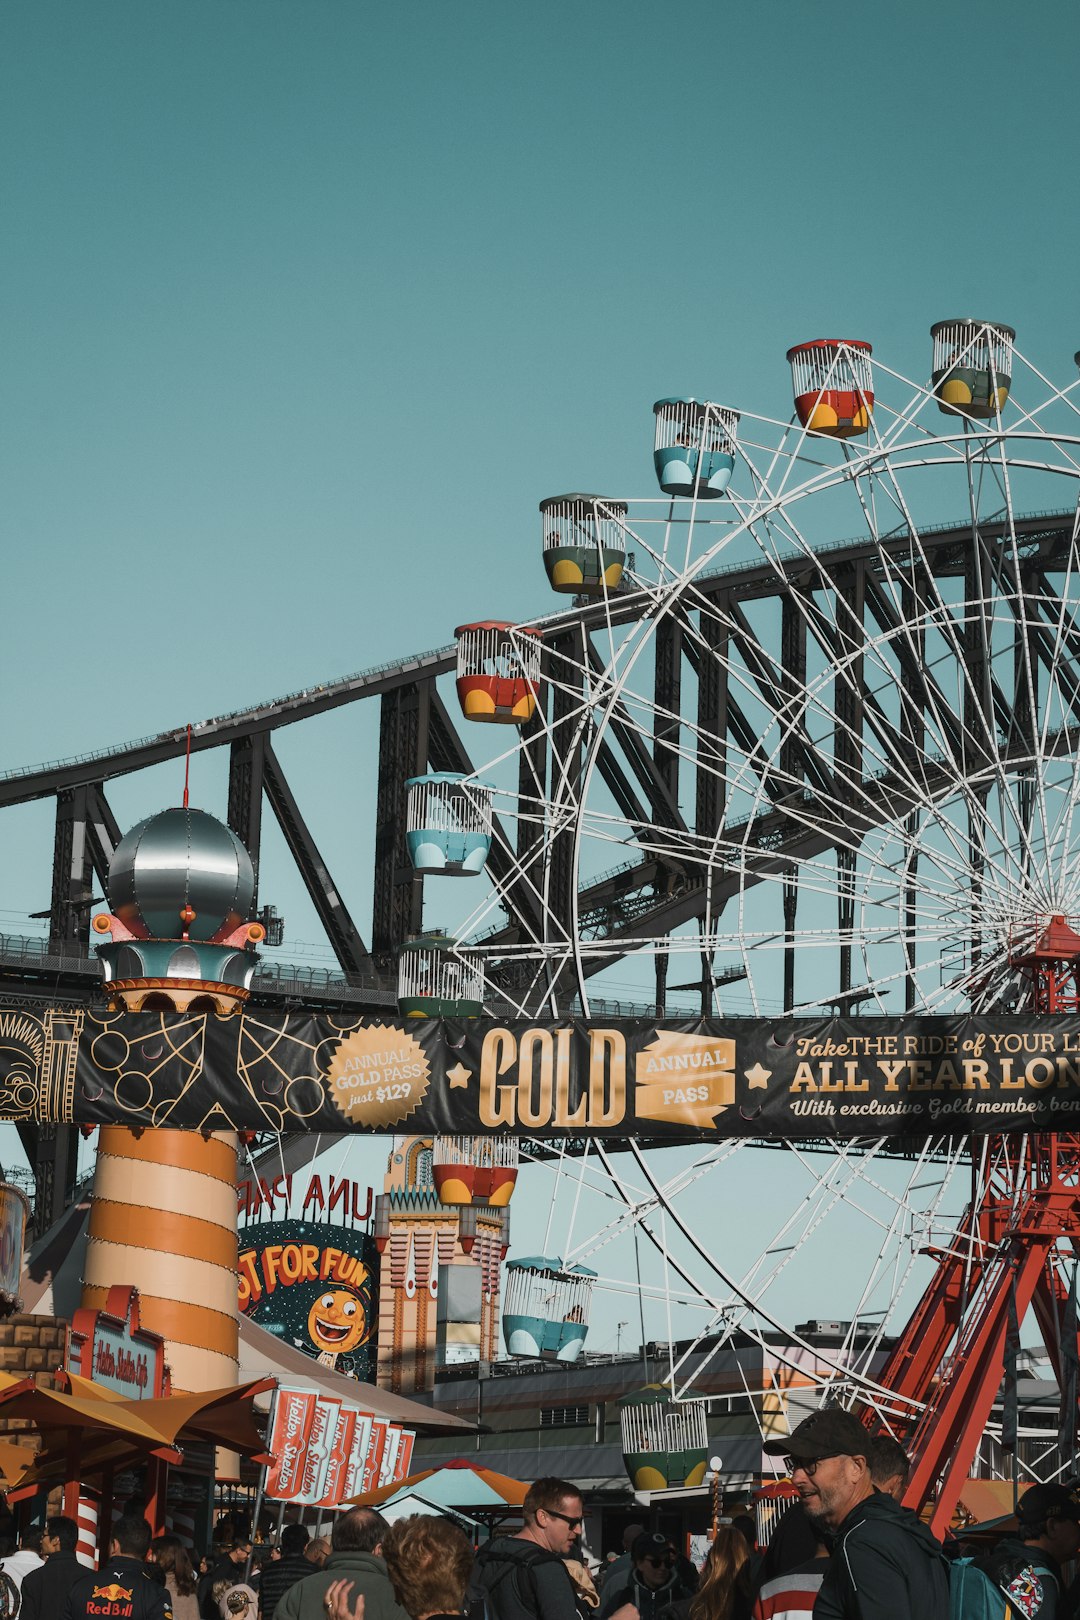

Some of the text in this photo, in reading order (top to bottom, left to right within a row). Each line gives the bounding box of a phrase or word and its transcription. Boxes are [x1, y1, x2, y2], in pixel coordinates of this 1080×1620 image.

[796, 1036, 850, 1057] Take
[847, 1035, 898, 1056] THE
[904, 1035, 958, 1056] RIDE
[962, 1032, 986, 1058] of
[991, 1033, 1056, 1054] YOUR
[343, 1048, 410, 1073] ANNUAL
[646, 1050, 727, 1073] ANNUAL
[336, 1063, 422, 1090] GOLD PASS
[479, 1028, 627, 1128] GOLD
[789, 1057, 1080, 1093] ALL YEAR LON
[348, 1082, 411, 1110] just $129
[663, 1085, 709, 1105] PASS
[789, 1099, 837, 1117] With
[840, 1098, 923, 1117] exclusive
[928, 1097, 973, 1120] Gold
[975, 1096, 1047, 1114] member
[262, 1244, 320, 1291] FOR
[321, 1247, 369, 1288] FUN
[286, 1396, 304, 1439] Helter
[310, 1405, 327, 1447] Helter
[86, 1601, 111, 1615] Red
